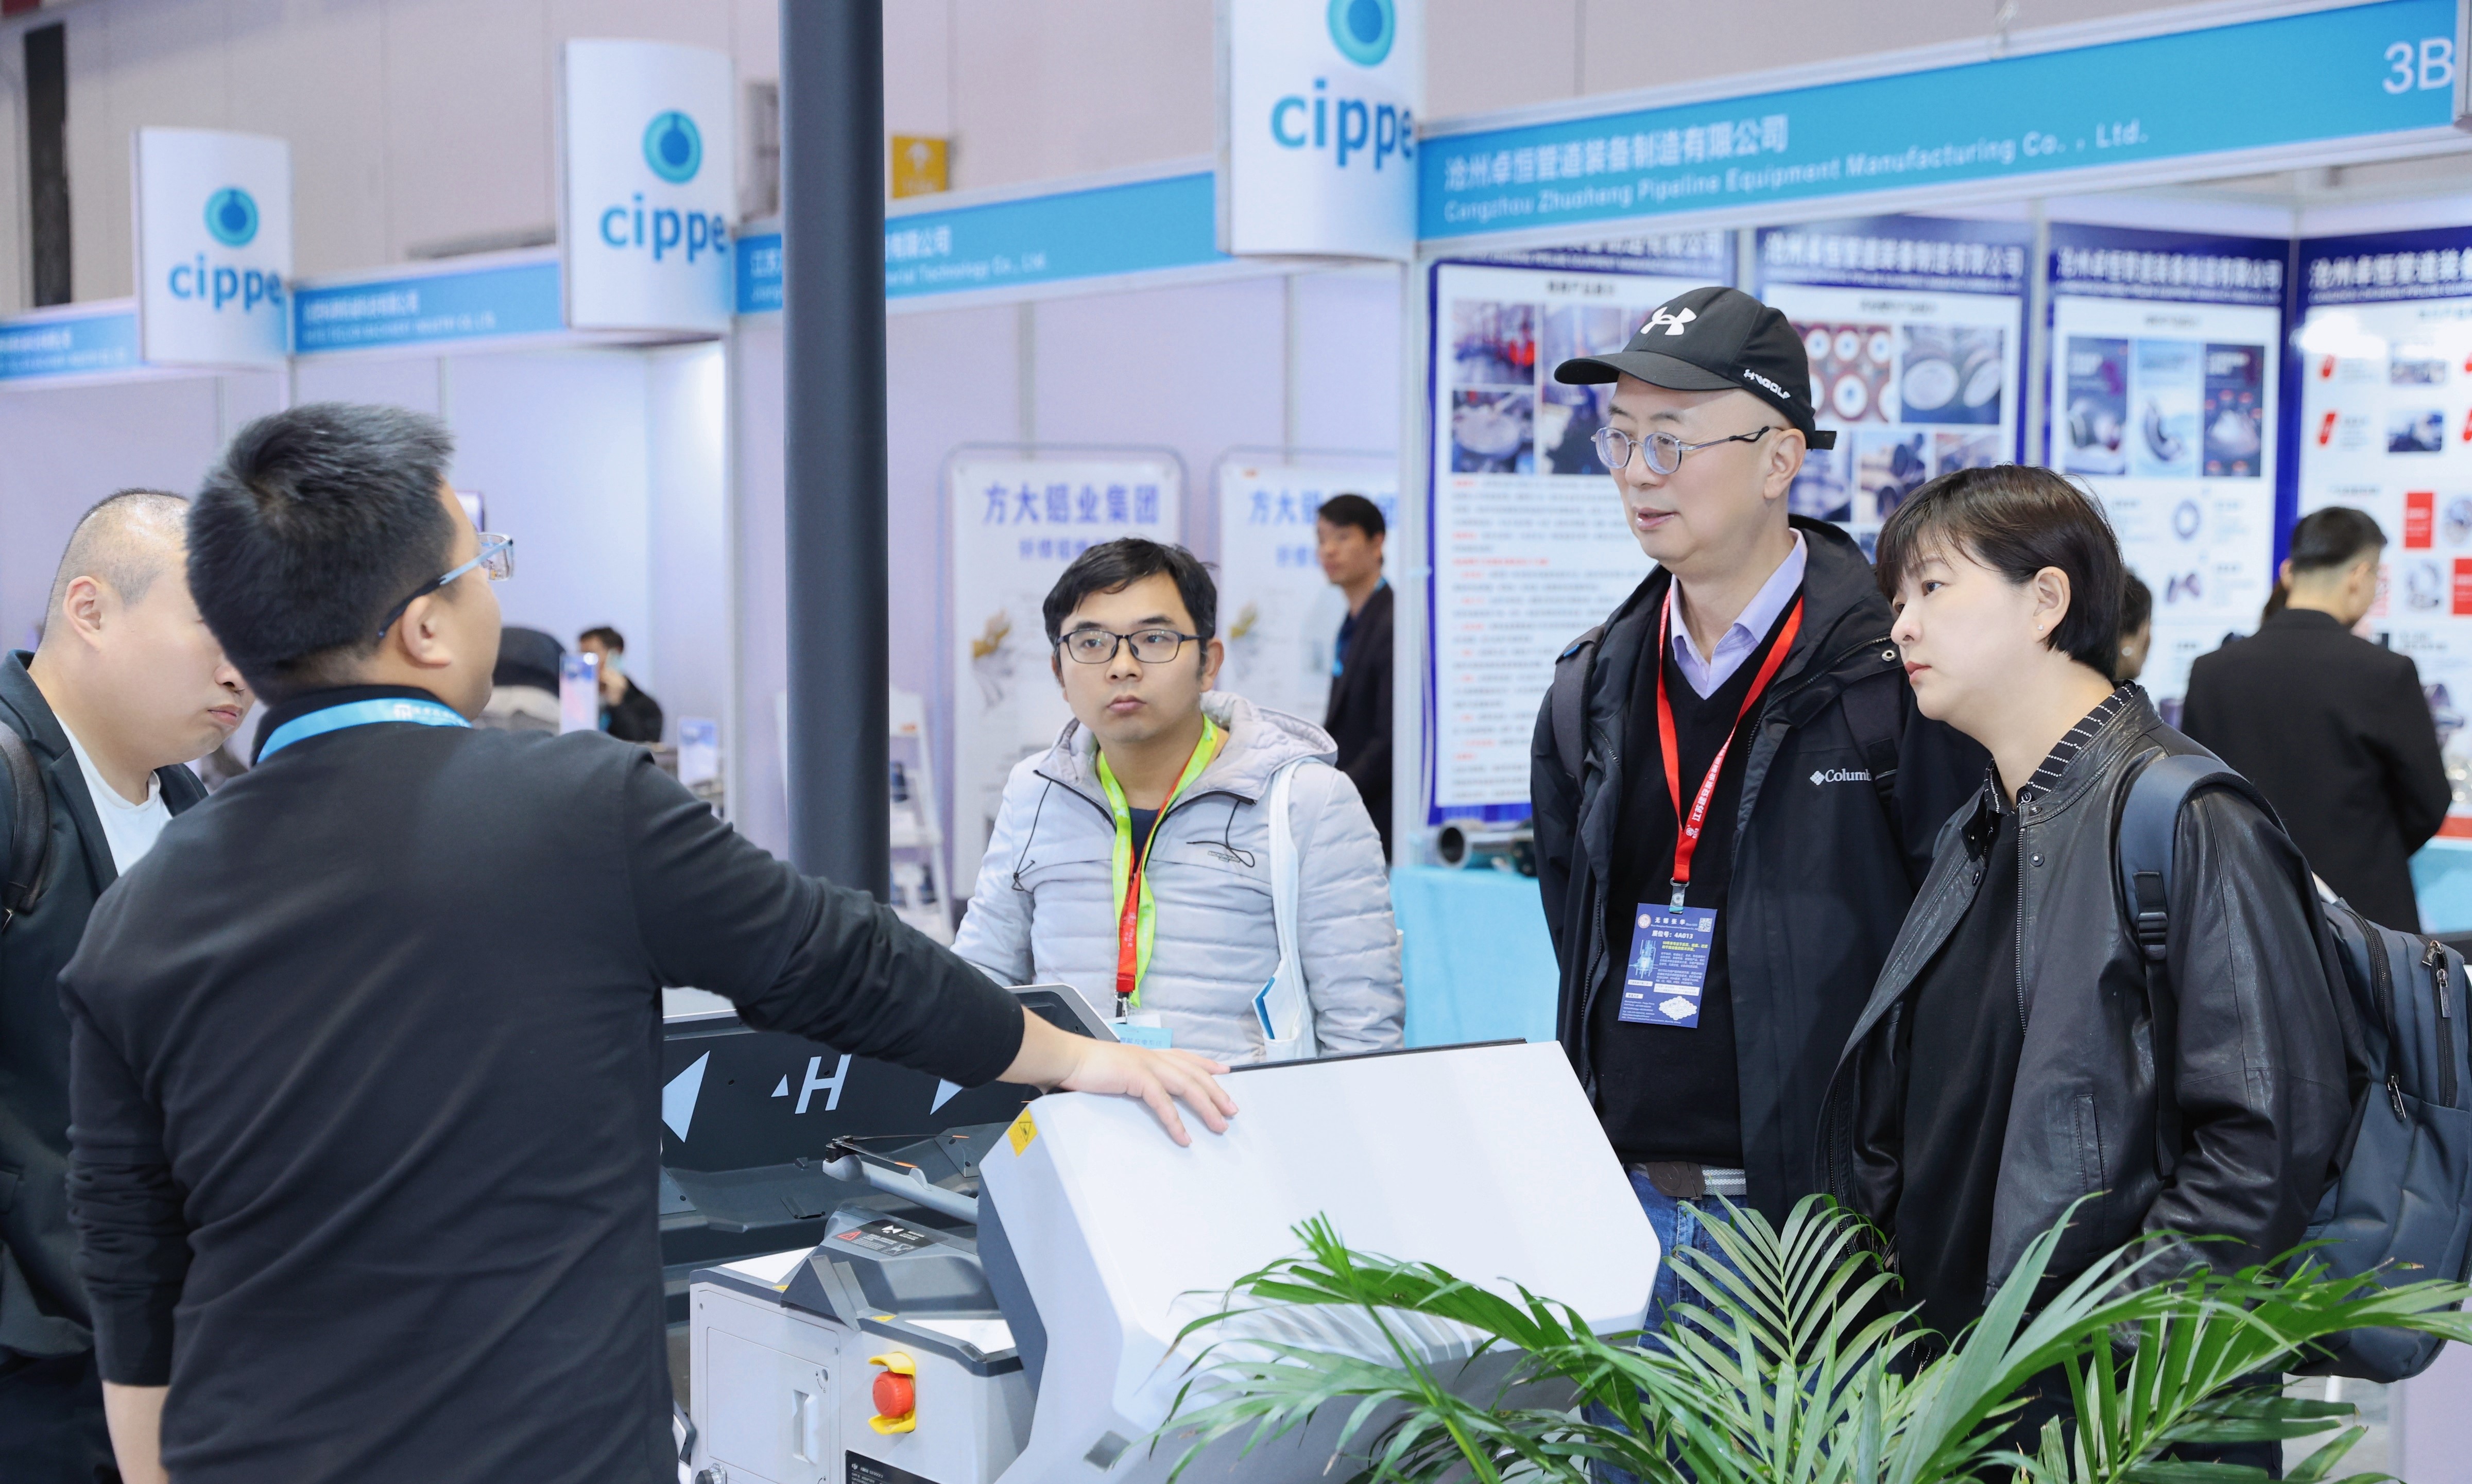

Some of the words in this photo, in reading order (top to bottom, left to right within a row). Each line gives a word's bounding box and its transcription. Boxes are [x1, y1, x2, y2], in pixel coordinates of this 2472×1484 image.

[2382, 37, 2455, 94] 3B
[1271, 78, 1412, 171] cippe
[1637, 173, 1721, 203] Pipeline
[1726, 157, 1840, 194] Equipment
[1846, 138, 2017, 176] Manufacturing
[600, 193, 727, 262] cippe
[168, 253, 284, 310] cippe
[1825, 768, 1872, 782] Columb
